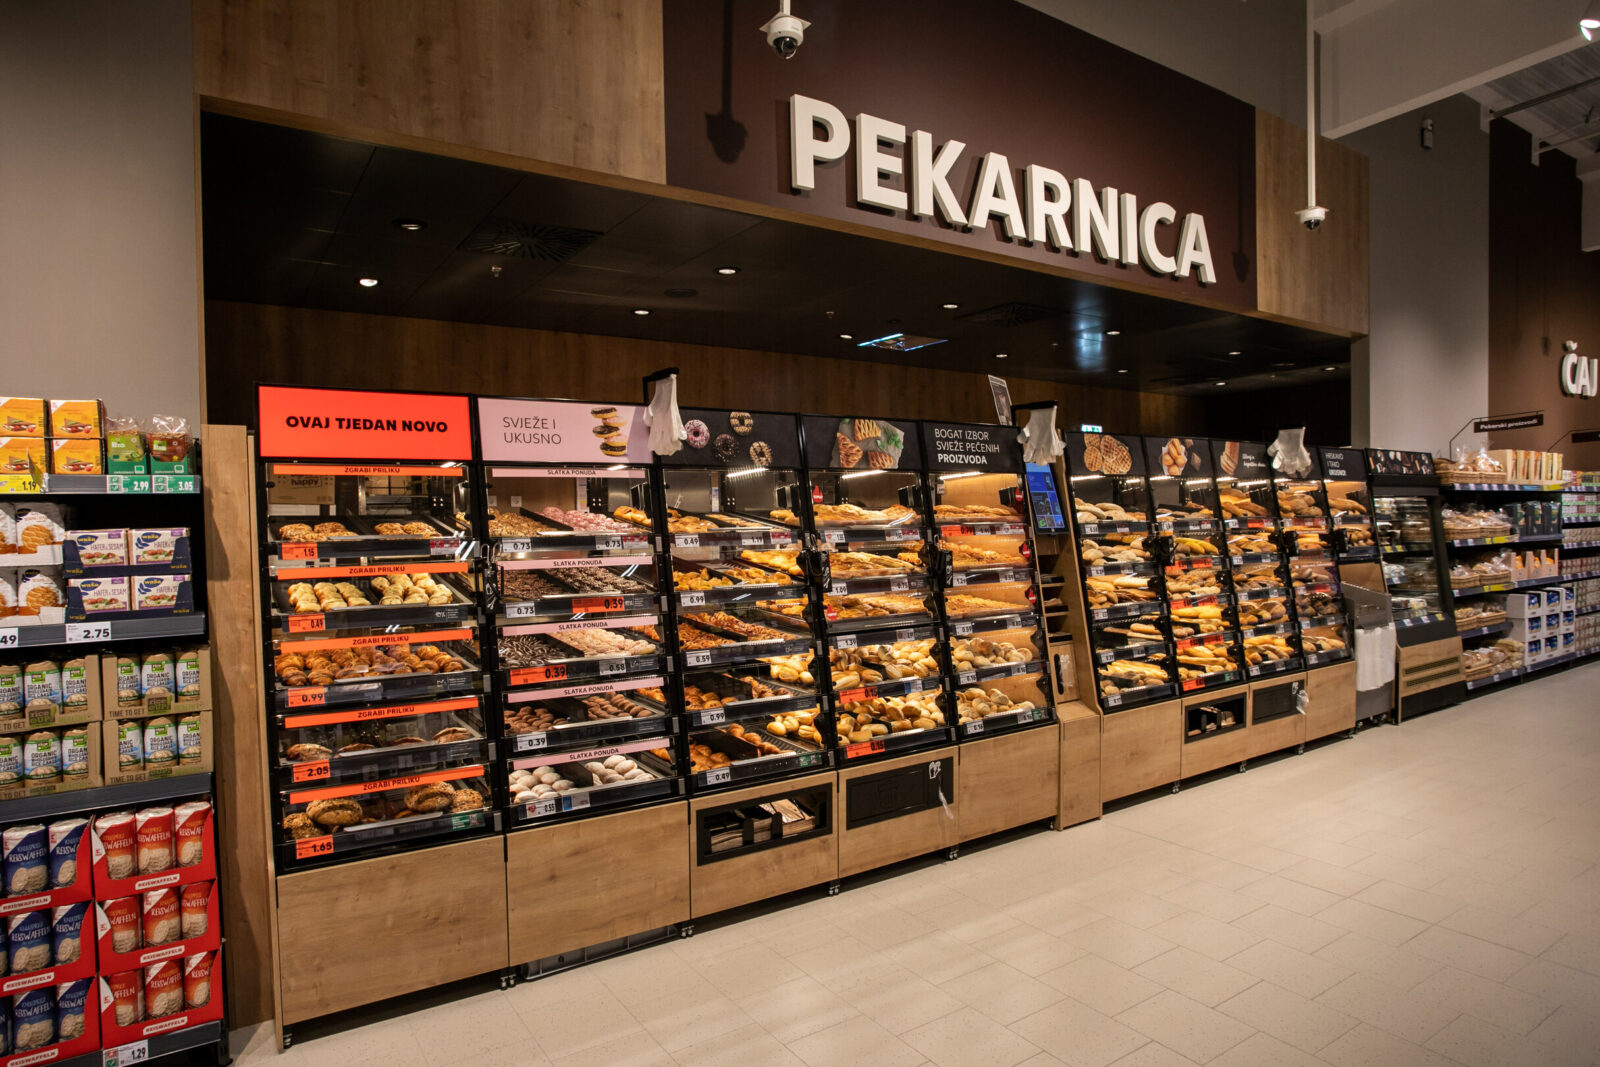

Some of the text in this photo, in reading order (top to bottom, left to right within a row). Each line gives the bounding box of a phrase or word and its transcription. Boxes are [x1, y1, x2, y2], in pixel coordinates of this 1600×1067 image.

[790, 93, 1217, 284] PEKARNICA
[1561, 340, 1599, 397] ČAJ
[286, 416, 448, 432] OVAJ TJEDAN NOVO
[502, 416, 556, 430] SVJEŽE I
[504, 432, 562, 445] UKUSNO
[934, 428, 990, 441] BOGAT IZBOR
[936, 440, 1000, 454] SVJEŽE PEČENIH
[937, 453, 988, 465] PROIZVODA
[22, 480, 36, 491] 1.19
[133, 481, 149, 491] 2.99
[178, 481, 193, 491] 3.05
[513, 542, 531, 550] 0.73
[112, 588, 126, 596] SESAM
[604, 598, 624, 610] 0.39
[516, 606, 534, 615] 0.73
[310, 619, 324, 629] 0.49
[0, 634, 17, 645] 49
[82, 628, 110, 640] 2.75
[352, 635, 410, 646] ZGRABI PRILIKU
[695, 655, 710, 663] 0.59
[544, 667, 566, 680] 0.39
[564, 684, 614, 696] SLATKA PONUDA
[302, 694, 324, 703] 0.99
[133, 708, 145, 716] GET
[357, 706, 414, 718] ZGRABI PRILIKU
[710, 712, 725, 722] 0.99
[13, 721, 25, 730] GET
[528, 738, 546, 747] 0.39
[30, 750, 57, 758] ORGANIC
[570, 748, 620, 760] SLATKA PONUDA
[134, 773, 146, 781] GET
[307, 766, 329, 777] 2.05
[716, 772, 730, 781] 0.49
[363, 776, 420, 791] ZGRABI PRILIKU
[311, 842, 333, 853] 1.65
[2, 898, 48, 910] REISWAFFELN
[6, 974, 52, 989] REISWAFFELN
[131, 1047, 146, 1060] 1.29
